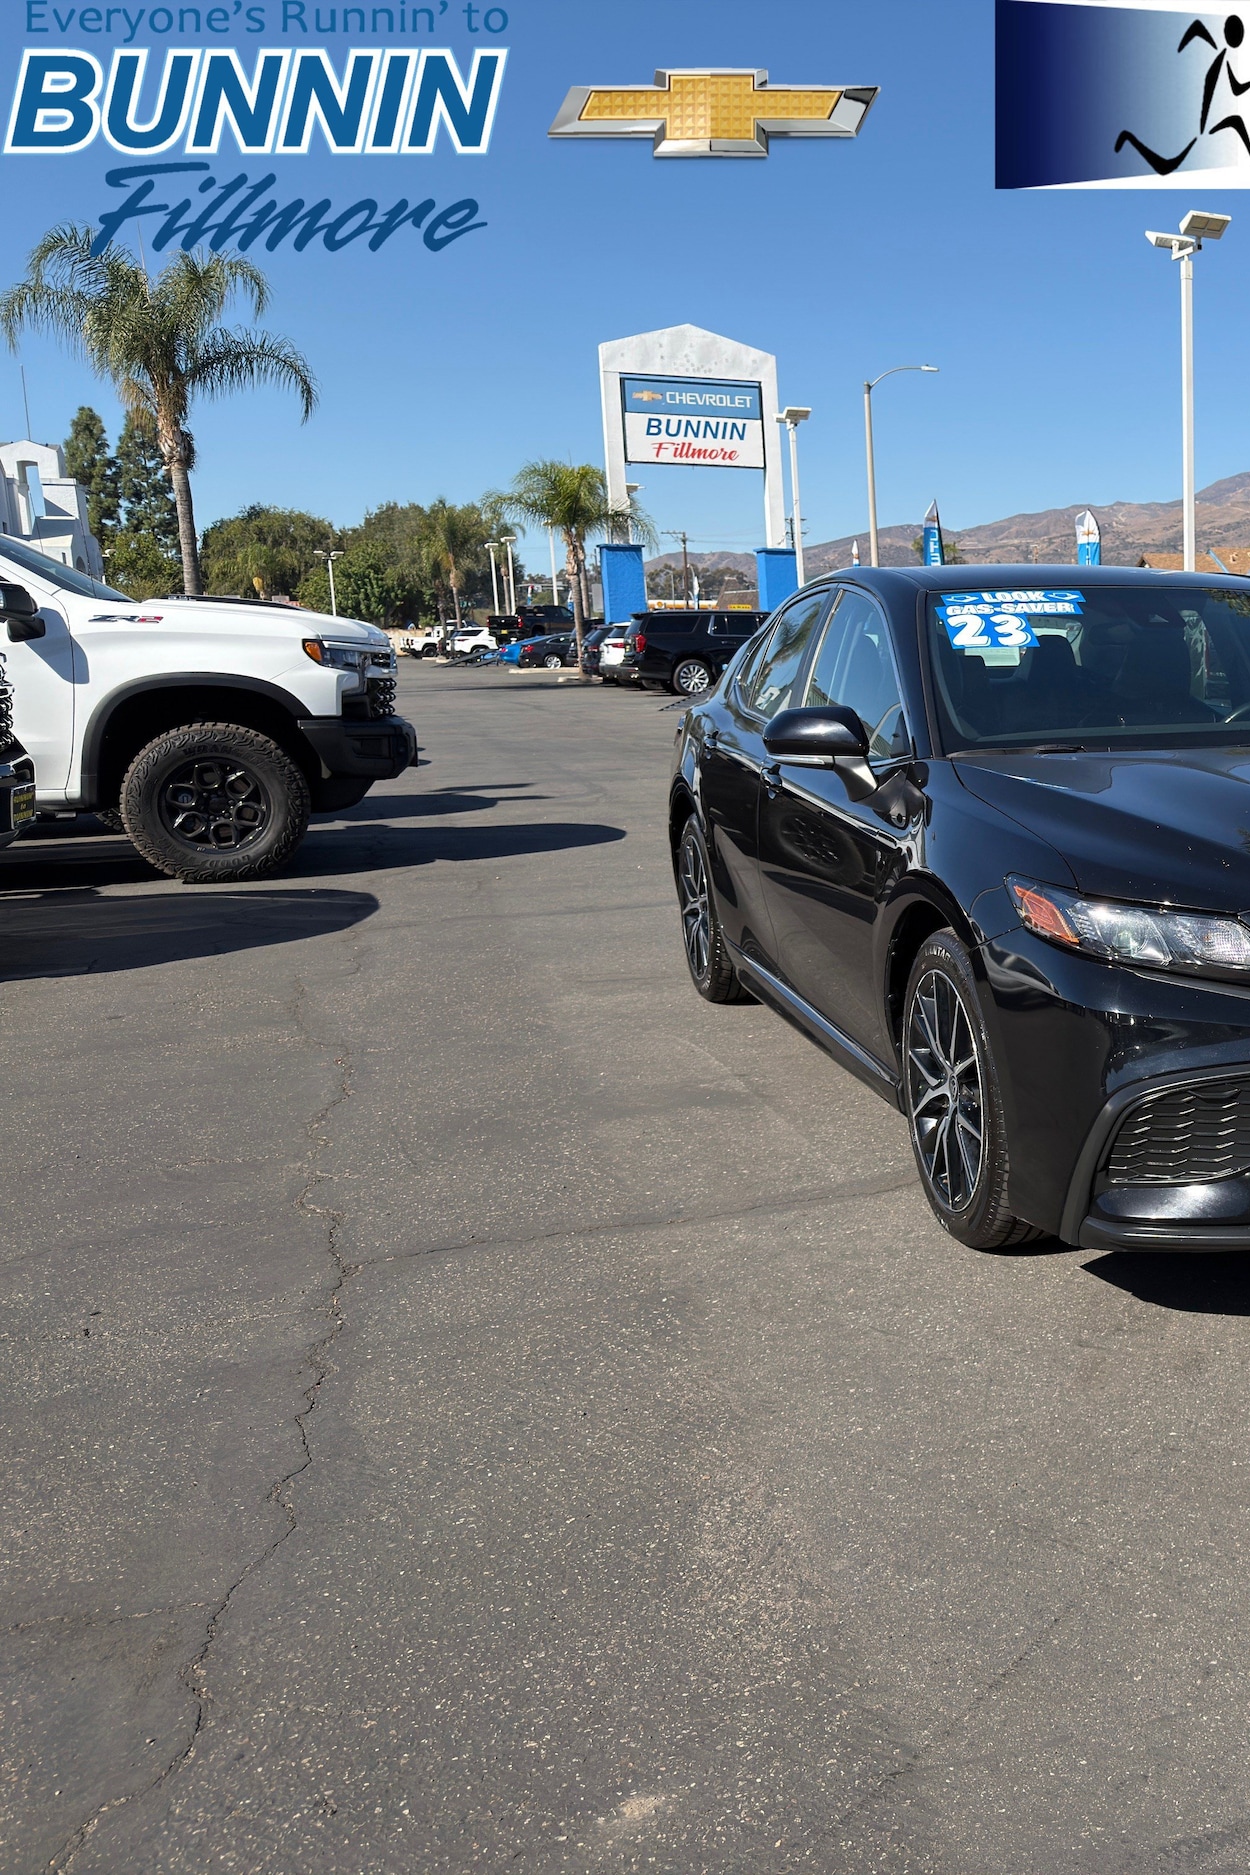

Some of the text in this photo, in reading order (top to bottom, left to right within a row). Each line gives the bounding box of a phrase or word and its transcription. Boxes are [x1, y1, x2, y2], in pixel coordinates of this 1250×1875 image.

[665, 391, 753, 409] CHEVROLET
[646, 417, 747, 441] BUNNIN
[651, 441, 740, 462] Fillmore
[981, 590, 1050, 602] LOOK
[946, 602, 1075, 616] GAS-SAVER
[88, 614, 164, 624] ZR2
[947, 614, 1032, 647] 23
